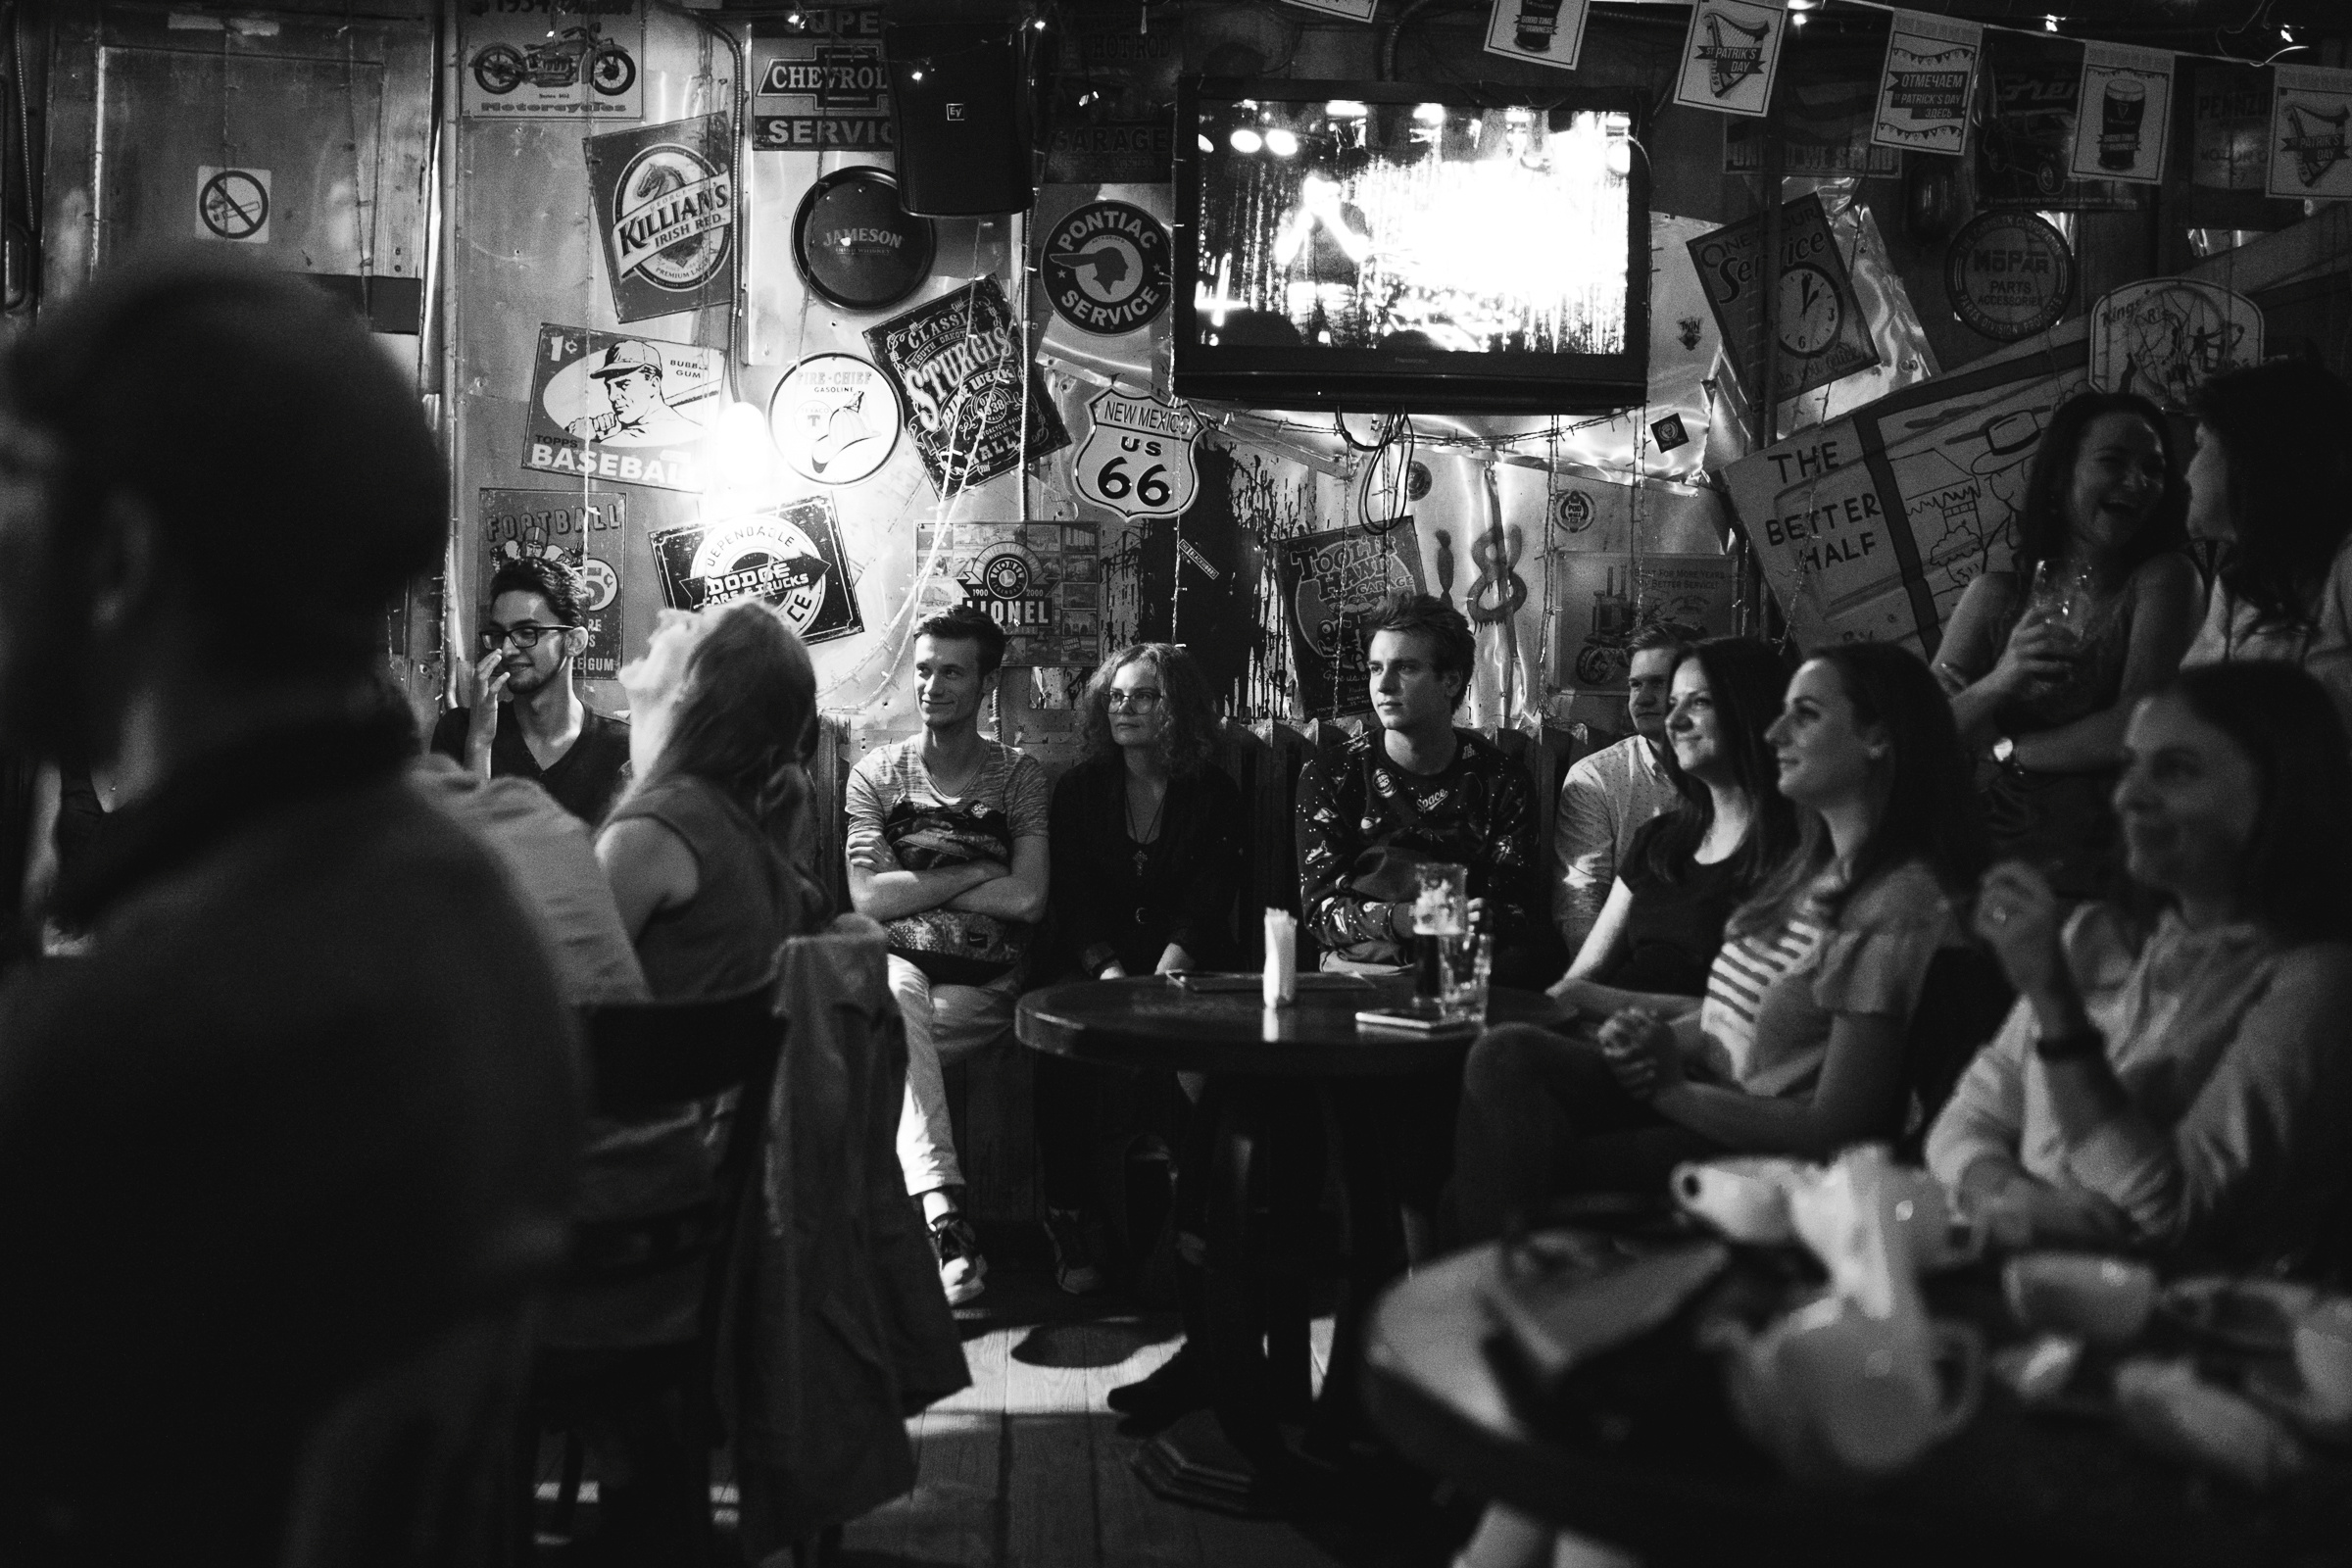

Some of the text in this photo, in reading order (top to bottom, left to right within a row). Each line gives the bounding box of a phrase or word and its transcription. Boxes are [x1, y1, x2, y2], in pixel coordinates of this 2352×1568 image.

[1539, 17, 1554, 25] TIME
[1093, 34, 1171, 58] HOT ROD
[1715, 47, 1757, 60] PATRIK'S
[1731, 61, 1751, 73] DAY
[1901, 74, 1964, 88] ОТМЕЧАЕМ
[1900, 92, 1944, 104] PATRICK'S
[1944, 94, 1962, 105] DAY
[1925, 108, 1953, 119] ЗДЕСЬ
[1052, 127, 1168, 152] GARAGE
[2317, 149, 2334, 160] DAY
[618, 182, 728, 257] KILLIAN'S
[655, 214, 722, 247] IRISH RED
[1057, 211, 1158, 252] PONTIAC
[822, 227, 903, 249] JAMESON
[1700, 232, 1752, 269] ONE
[1973, 248, 2049, 273] MOPAR
[656, 267, 689, 278] PREMIUM
[1719, 230, 1825, 304] Serice
[1990, 280, 2032, 294] PARTS
[1061, 286, 1159, 326] SERVICE
[1827, 307, 1836, 322] 3
[1958, 294, 1983, 321] PARTS
[1982, 318, 2019, 335] DIVISION
[913, 329, 970, 367] SOUTH DAKOT
[1797, 335, 1807, 350] 6
[675, 369, 702, 379] GUM
[905, 325, 1012, 432] STURGIS
[1104, 401, 1192, 435] NEW MEXICO
[535, 434, 578, 448] TOPPS
[1767, 441, 1839, 484] THE
[1098, 457, 1172, 508] 66
[486, 504, 621, 542] FOOTBALL
[1765, 493, 1882, 546] BETTER
[707, 525, 795, 567] DEPENDABLE
[1799, 532, 1877, 574] HALF
[708, 563, 791, 596] DODGE
[756, 573, 809, 597] TRUCKS
[1356, 574, 1414, 595] GARAGE
[1651, 578, 1682, 588] BETTER
[1677, 569, 1697, 579] MORE
[972, 588, 1044, 598] 1900 2000
[967, 600, 1050, 624] IONEL
[588, 658, 614, 671] GUM
[1415, 787, 1449, 813] Space
